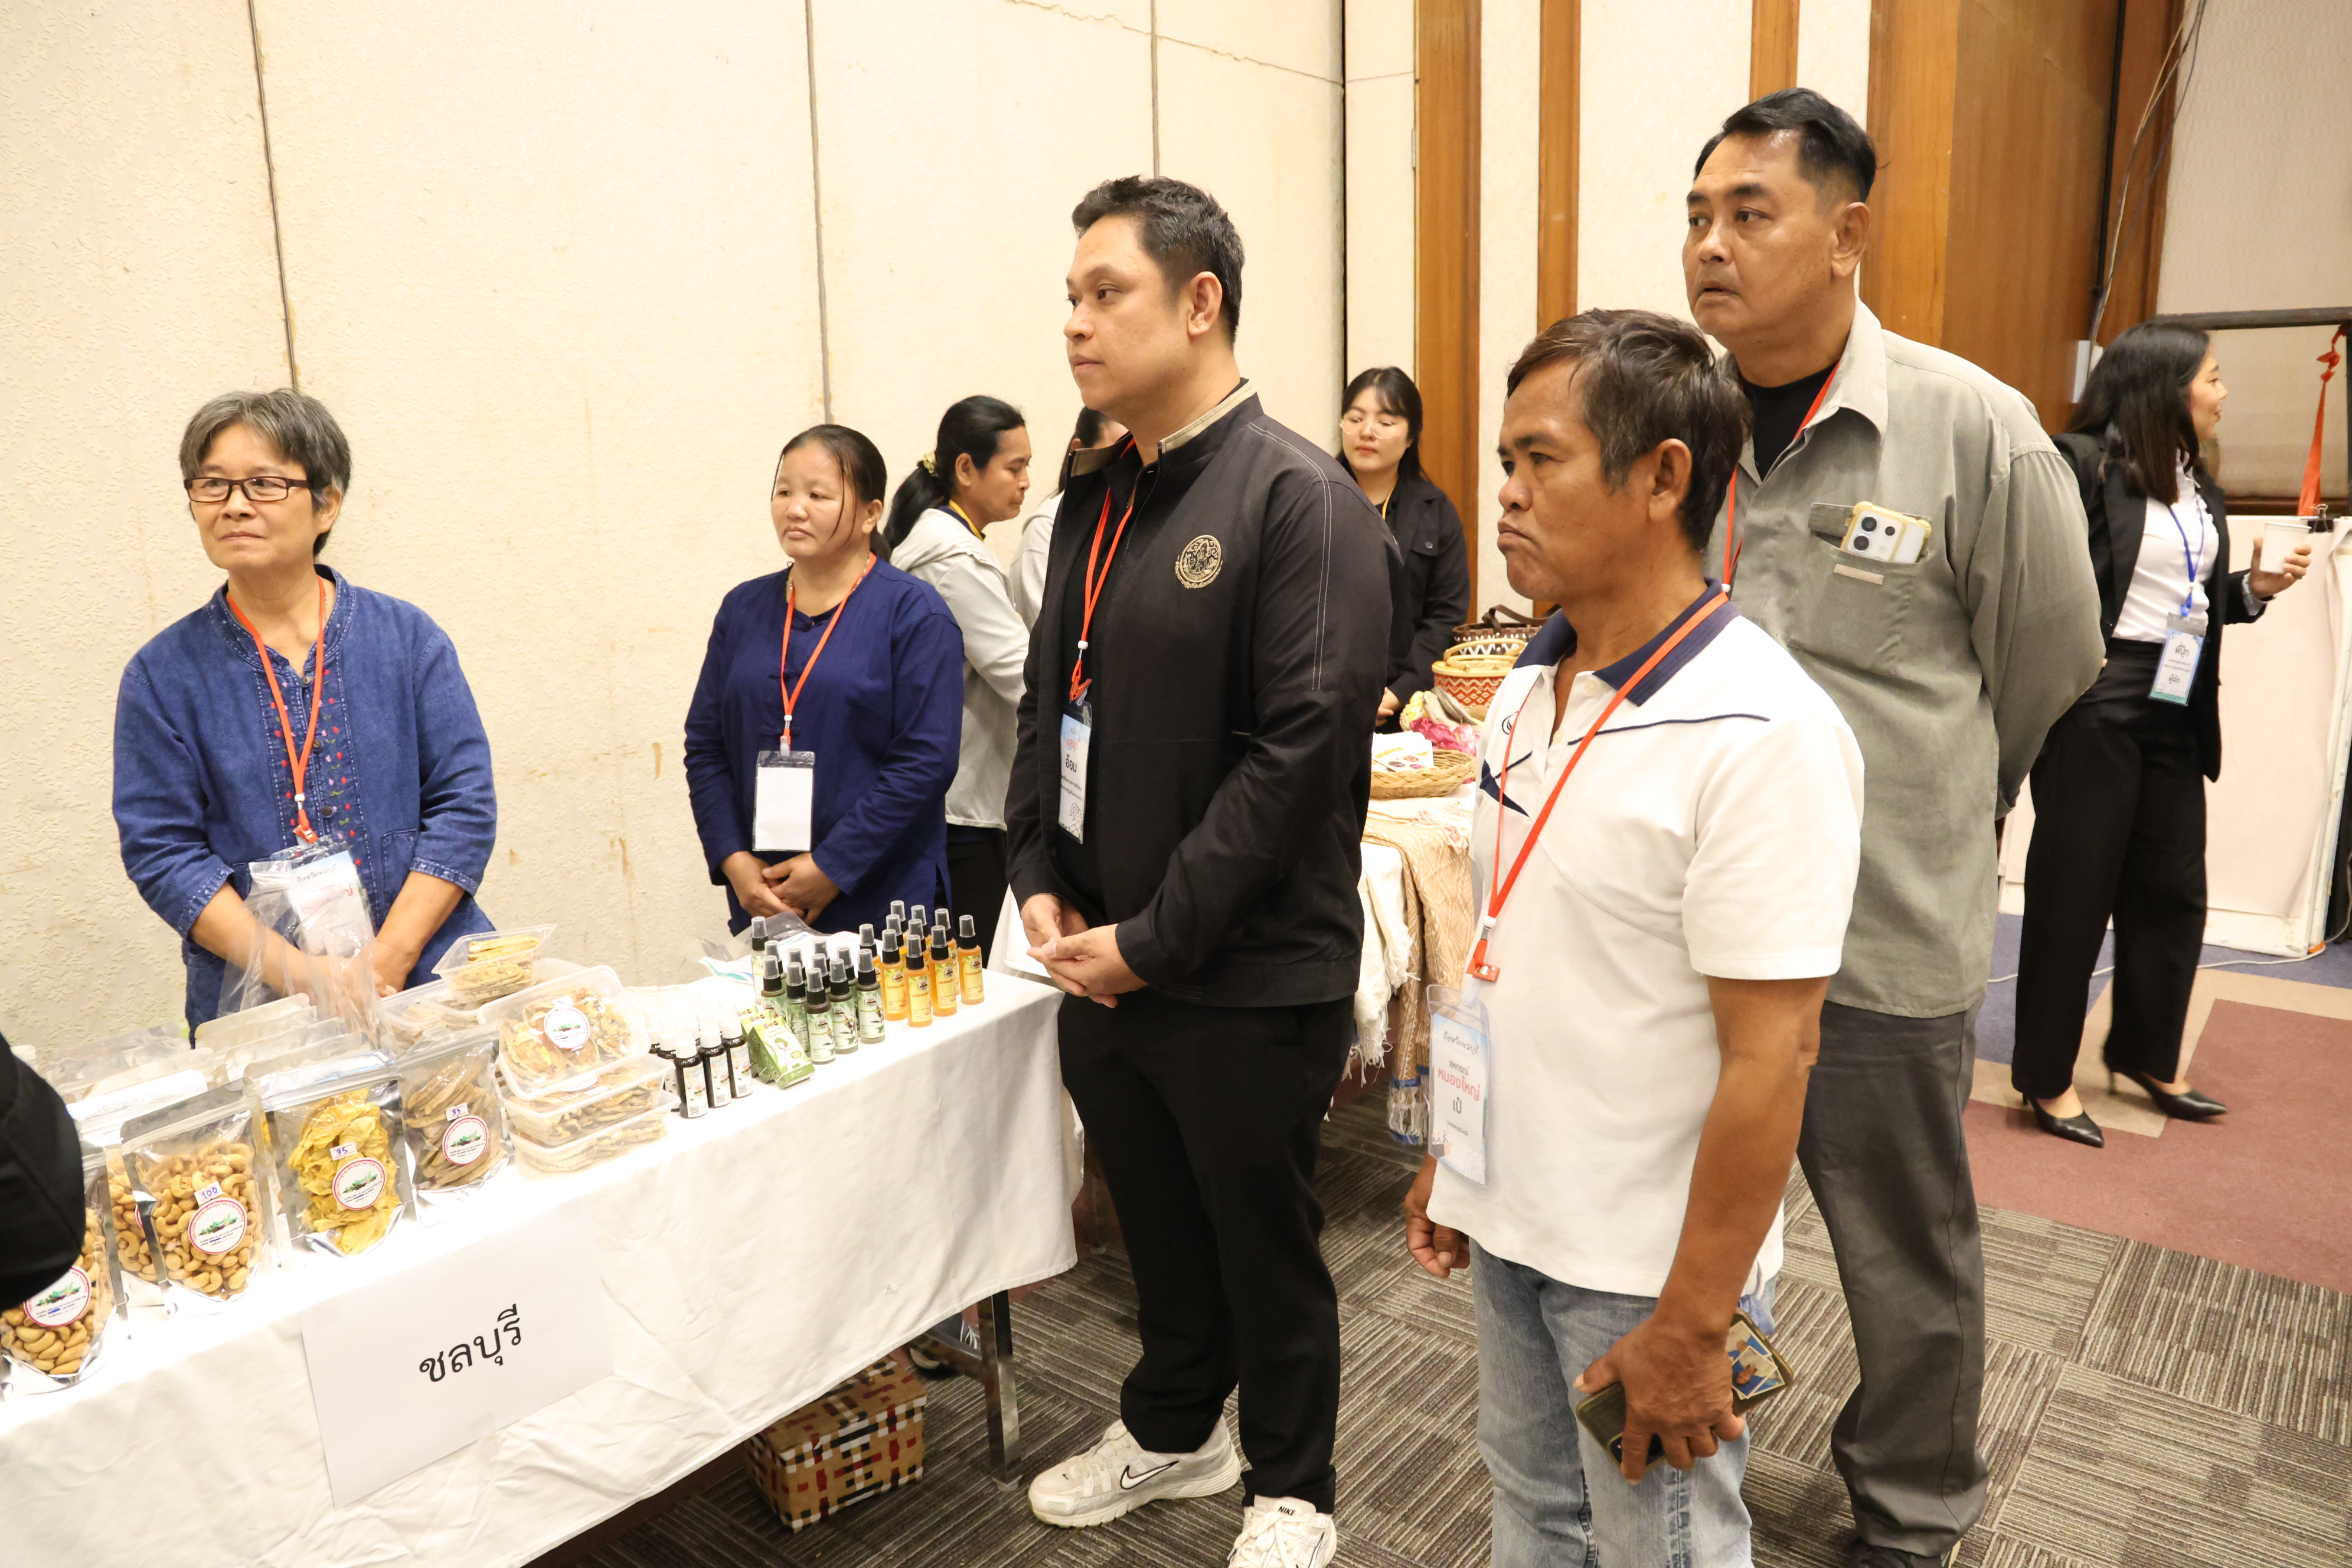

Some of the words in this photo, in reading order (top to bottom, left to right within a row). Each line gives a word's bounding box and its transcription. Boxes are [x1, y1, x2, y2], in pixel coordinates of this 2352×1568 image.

[1067, 737, 1080, 753] ชลบุรี
[1065, 754, 1077, 773] อ้อน
[1449, 1060, 1469, 1076] สหกรณ์
[1438, 1067, 1481, 1102] หนองใหญ่
[336, 1146, 348, 1155] 35
[201, 1187, 218, 1199] 100
[419, 1303, 522, 1383] ชลบุรี
[1278, 1506, 1296, 1516] NIKE
